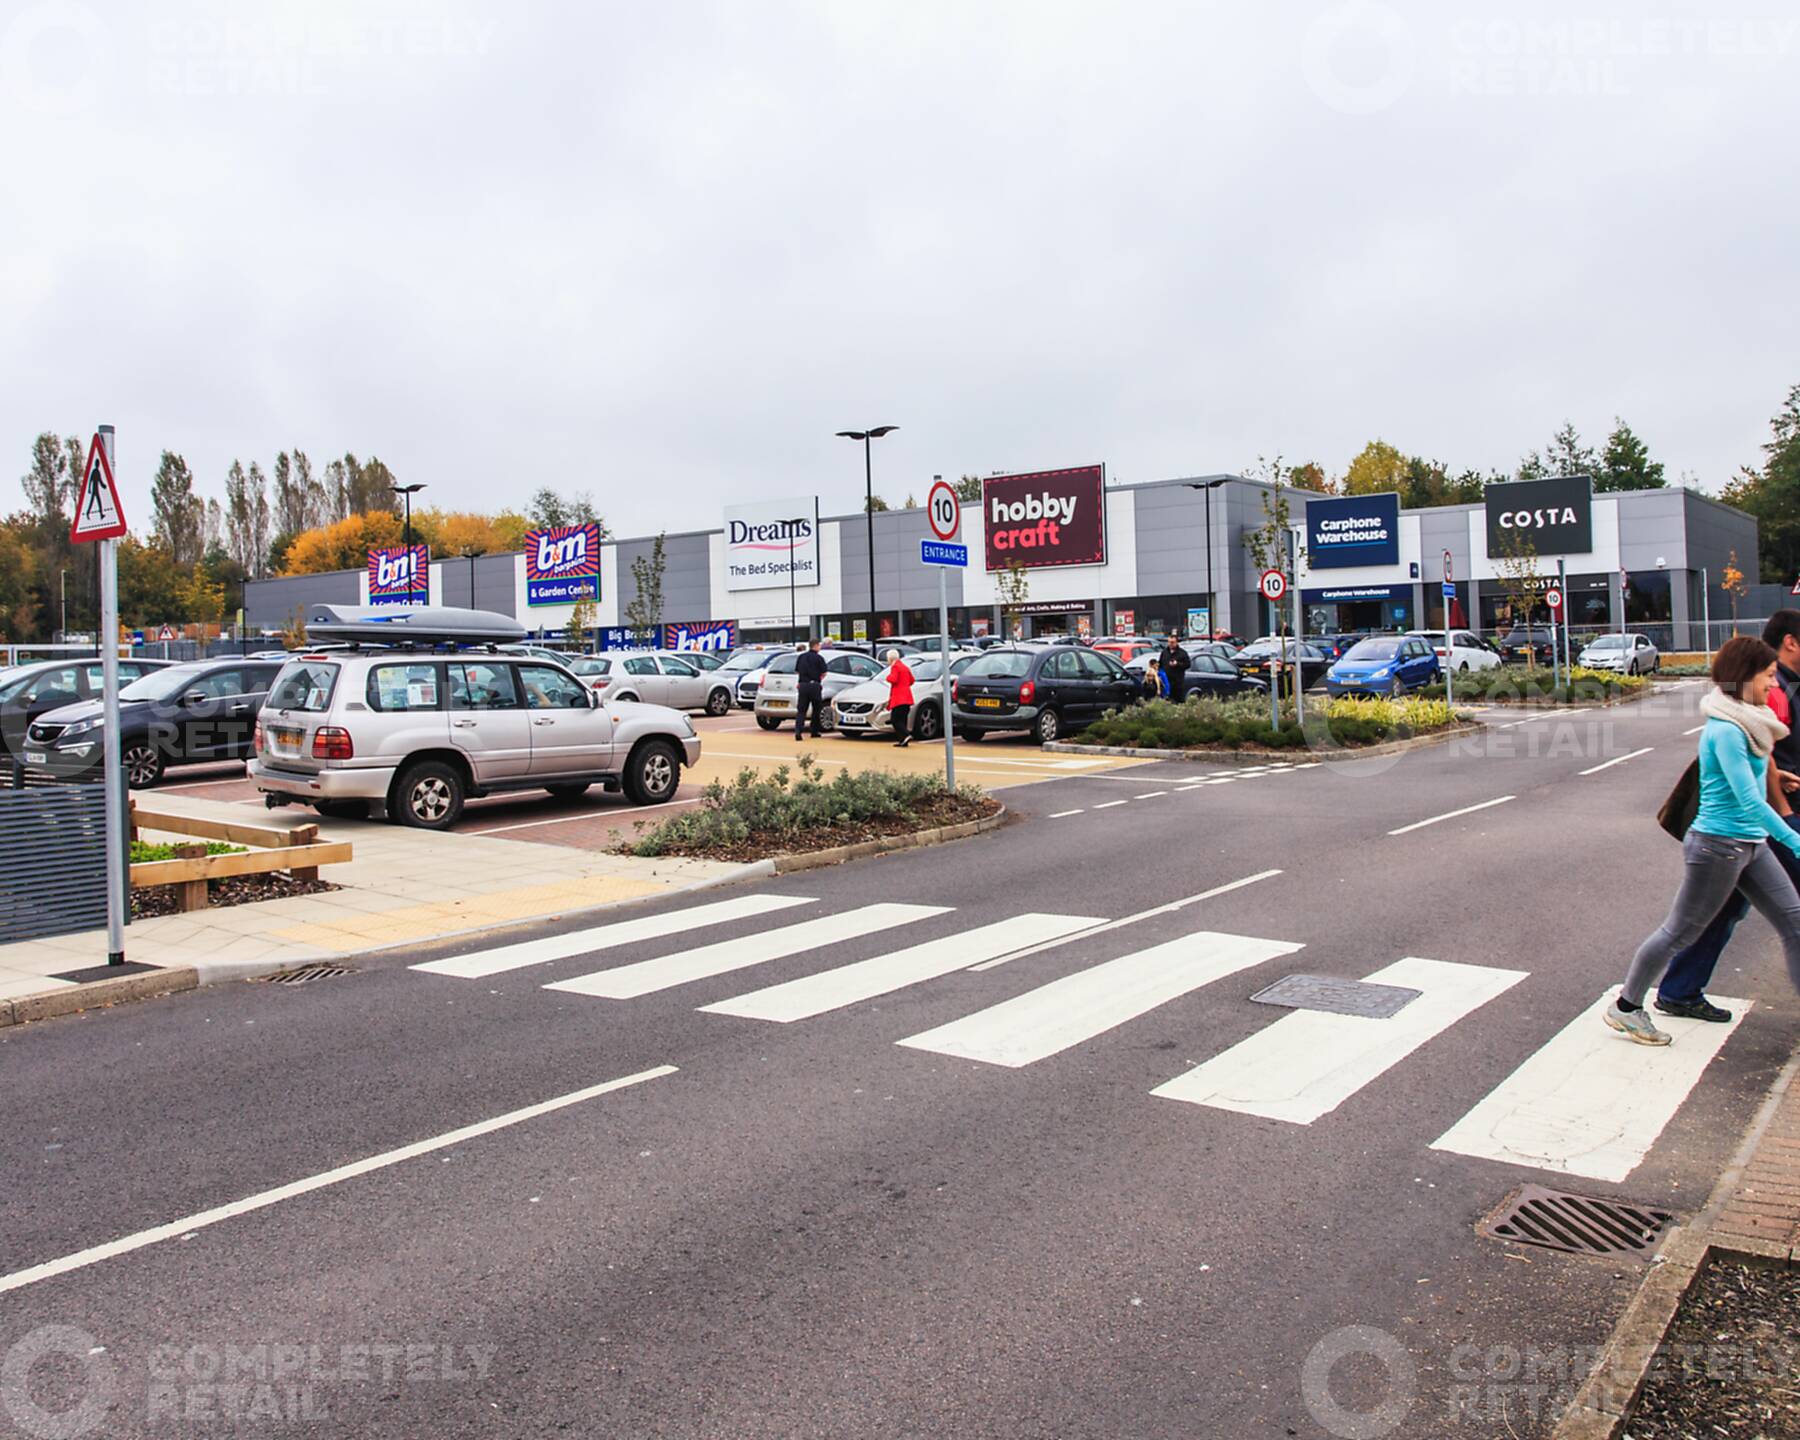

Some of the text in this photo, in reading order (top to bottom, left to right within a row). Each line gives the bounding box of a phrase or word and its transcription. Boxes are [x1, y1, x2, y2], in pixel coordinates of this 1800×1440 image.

[934, 498, 953, 523] 10
[991, 492, 1077, 525] hobby
[1320, 517, 1381, 531] Carphone
[1499, 507, 1577, 528] COSTA
[728, 519, 812, 544] Dreams
[993, 518, 1060, 550] craft
[1316, 529, 1388, 543] Warehouse
[924, 545, 966, 561] ENTRANCE
[729, 560, 813, 576] The Bed Specalist
[538, 586, 566, 597] Garden
[1266, 579, 1281, 591] 10
[1523, 579, 1560, 589] COSTA
[1548, 594, 1558, 603] 10
[608, 630, 622, 643] Big
